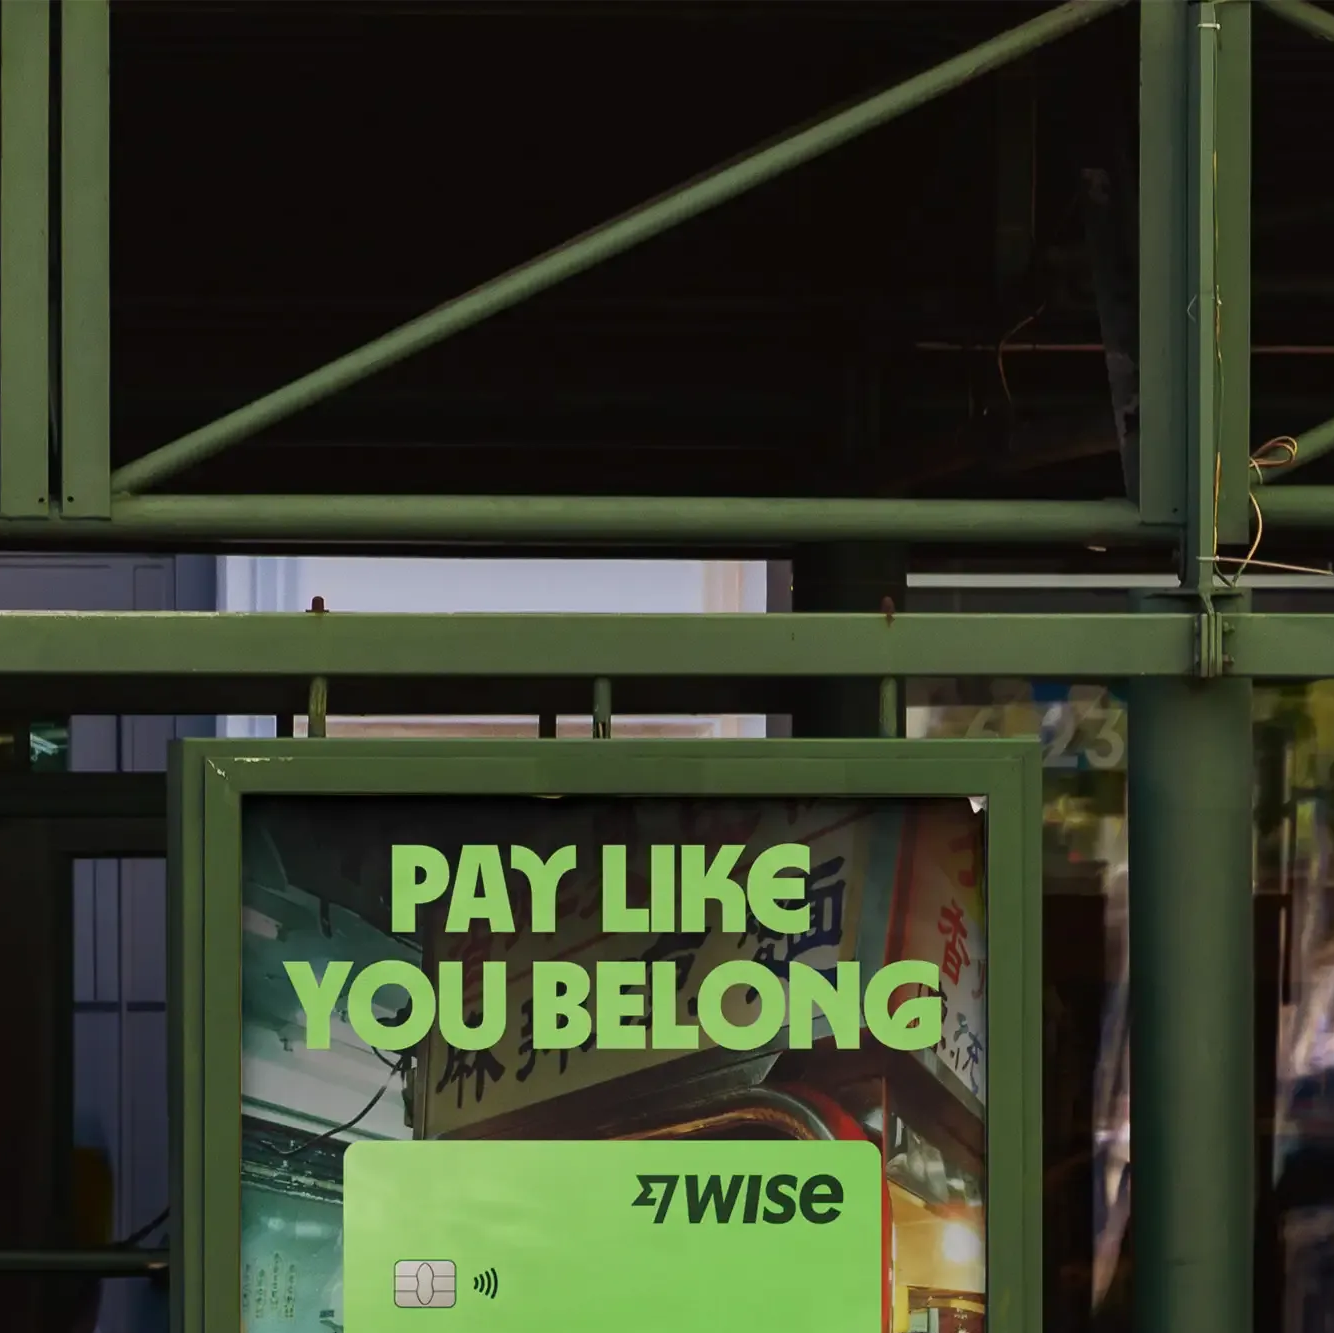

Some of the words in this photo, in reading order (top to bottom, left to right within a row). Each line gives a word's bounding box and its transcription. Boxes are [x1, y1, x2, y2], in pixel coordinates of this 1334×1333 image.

[392, 844, 576, 933] PAY
[603, 844, 810, 934] LIKE
[284, 960, 507, 1051] YOU
[532, 960, 942, 1051] BELONG
